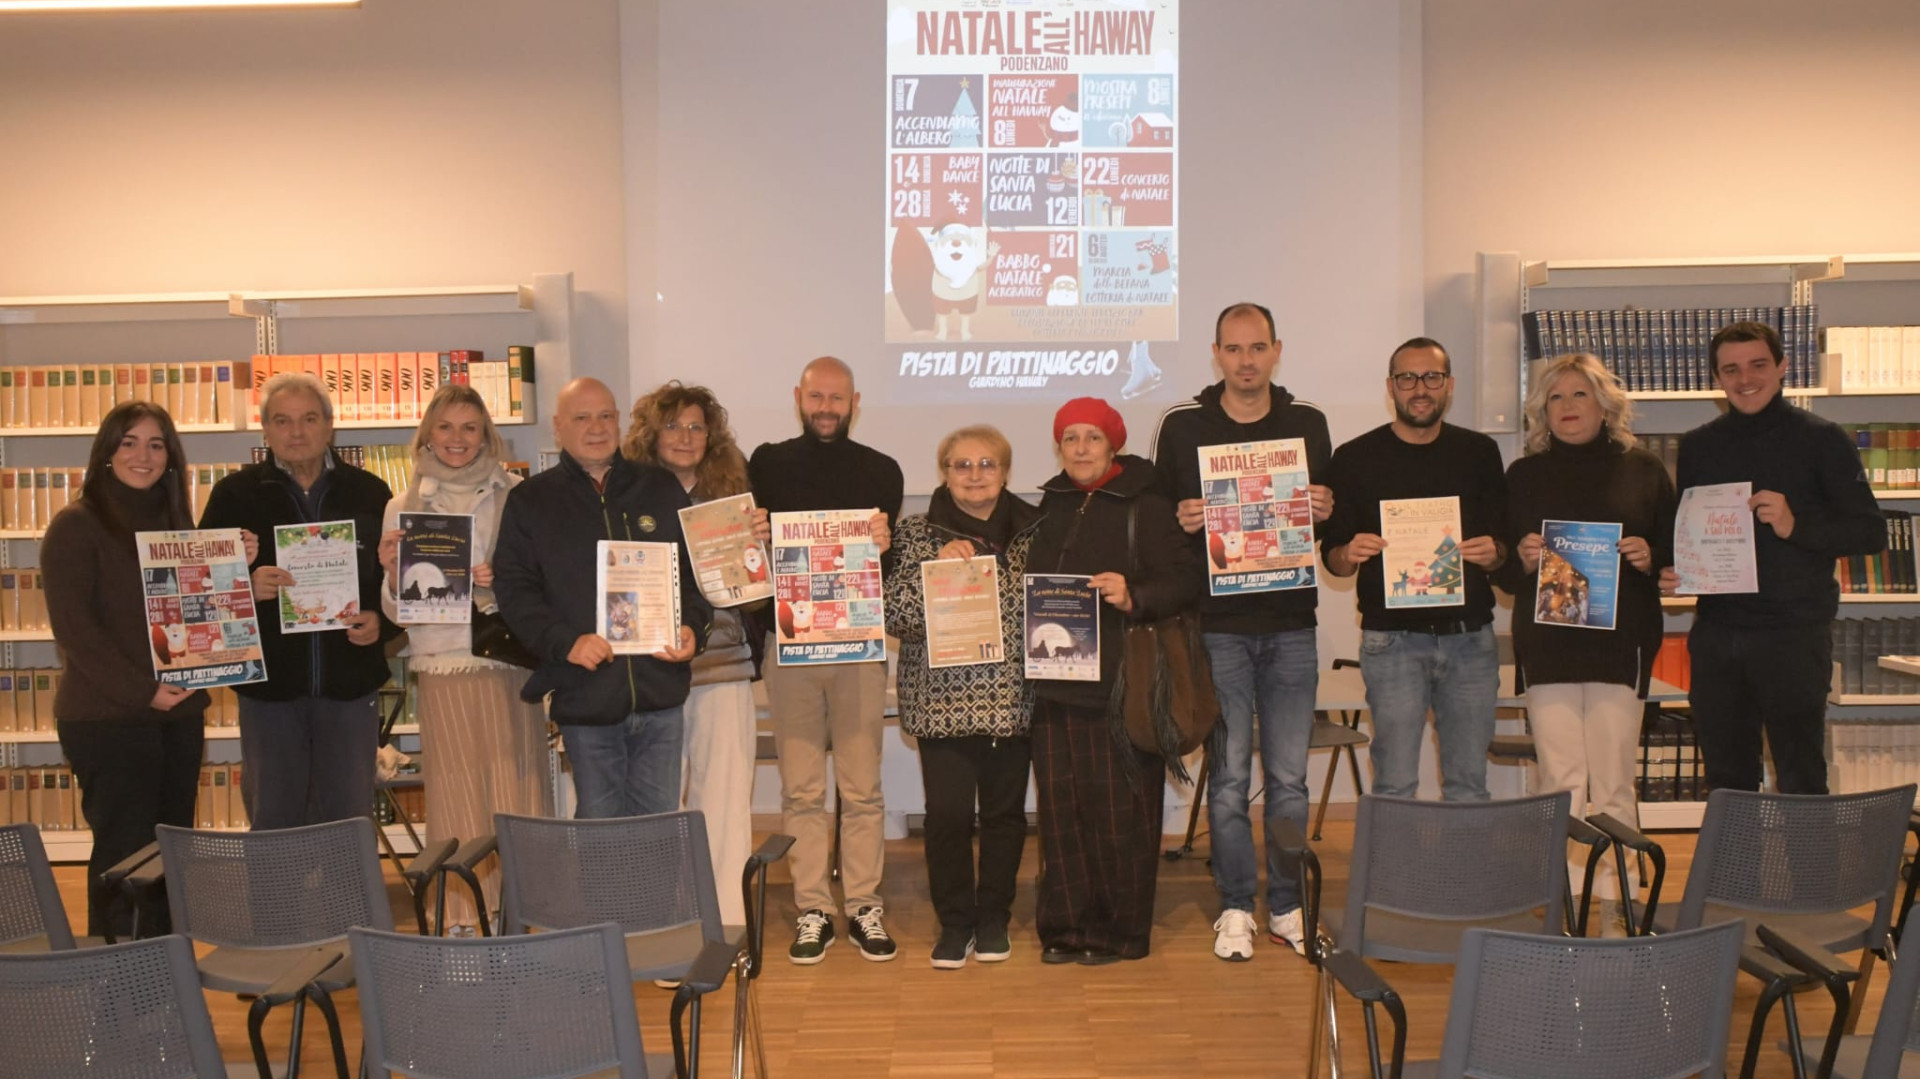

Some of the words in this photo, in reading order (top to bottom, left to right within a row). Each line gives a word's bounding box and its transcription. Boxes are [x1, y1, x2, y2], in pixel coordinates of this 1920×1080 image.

[917, 11, 1042, 55] NATALE
[1043, 11, 1070, 55] ALL'
[1074, 11, 1155, 55] HAWAY
[1000, 56, 1068, 71] PODENZANO
[904, 78, 919, 111] 7
[1084, 78, 1137, 95] MOSTRA
[1148, 79, 1160, 105] 8
[992, 88, 1048, 104] NATALE
[895, 115, 980, 130] ACCENDIAMO
[896, 131, 951, 145] L'ALBERO
[994, 120, 1005, 145] 8
[894, 156, 919, 183] 14
[949, 156, 980, 169] BABY
[989, 154, 1032, 174] NOTTE
[1035, 157, 1050, 174] DI
[942, 170, 979, 183] DANCE
[1083, 157, 1110, 185] 22
[1121, 173, 1170, 185] CONCERTO
[989, 175, 1035, 193] SANTA
[1131, 188, 1170, 201] NATALE
[894, 190, 921, 218] 28
[989, 194, 1032, 212] LUCIA
[1045, 196, 1068, 225] 12
[1055, 234, 1075, 258] 21
[1087, 234, 1098, 258] 6
[996, 254, 1040, 270] BABBO
[994, 270, 1043, 286] NATALE
[1093, 266, 1131, 278] MARCIA
[988, 286, 1043, 297] ACROBATICO
[1114, 278, 1150, 289] BEFANA
[1086, 292, 1125, 303] LOTTERIA
[1136, 293, 1168, 303] NATALE
[899, 351, 957, 377] PISTA
[960, 351, 983, 376] DI
[986, 349, 1119, 375] PATTINAGGIO
[342, 369, 354, 392] 900
[360, 369, 373, 392] 900
[380, 368, 393, 391] 900
[400, 367, 414, 390] 900
[422, 367, 436, 390] 900
[968, 376, 1014, 388] GIARDINO
[1210, 453, 1257, 473] NATALE
[1268, 450, 1298, 468] HAWAY
[1275, 503, 1286, 513] 22
[1263, 518, 1272, 529] 12
[1707, 512, 1738, 526] Natale
[782, 521, 830, 540] NATALE
[841, 520, 872, 538] HAWAY
[149, 542, 195, 560] NATALE
[204, 539, 236, 558] HAWAY
[1553, 536, 1610, 557] Presepe
[776, 577, 786, 587] 14
[846, 574, 857, 584] 22
[1215, 575, 1237, 586] PISTA
[1237, 575, 1247, 585] DI
[1247, 571, 1296, 585] PATTINAGGIO
[216, 594, 228, 606] 22
[833, 589, 843, 600] 12
[205, 610, 214, 621] 12
[783, 645, 805, 656] PISTA
[805, 645, 815, 655] DI
[815, 642, 864, 655] PATTINAGGIO
[161, 671, 182, 683] PISTA
[182, 669, 191, 681] DI
[192, 664, 244, 680] PATTINAGGIO
